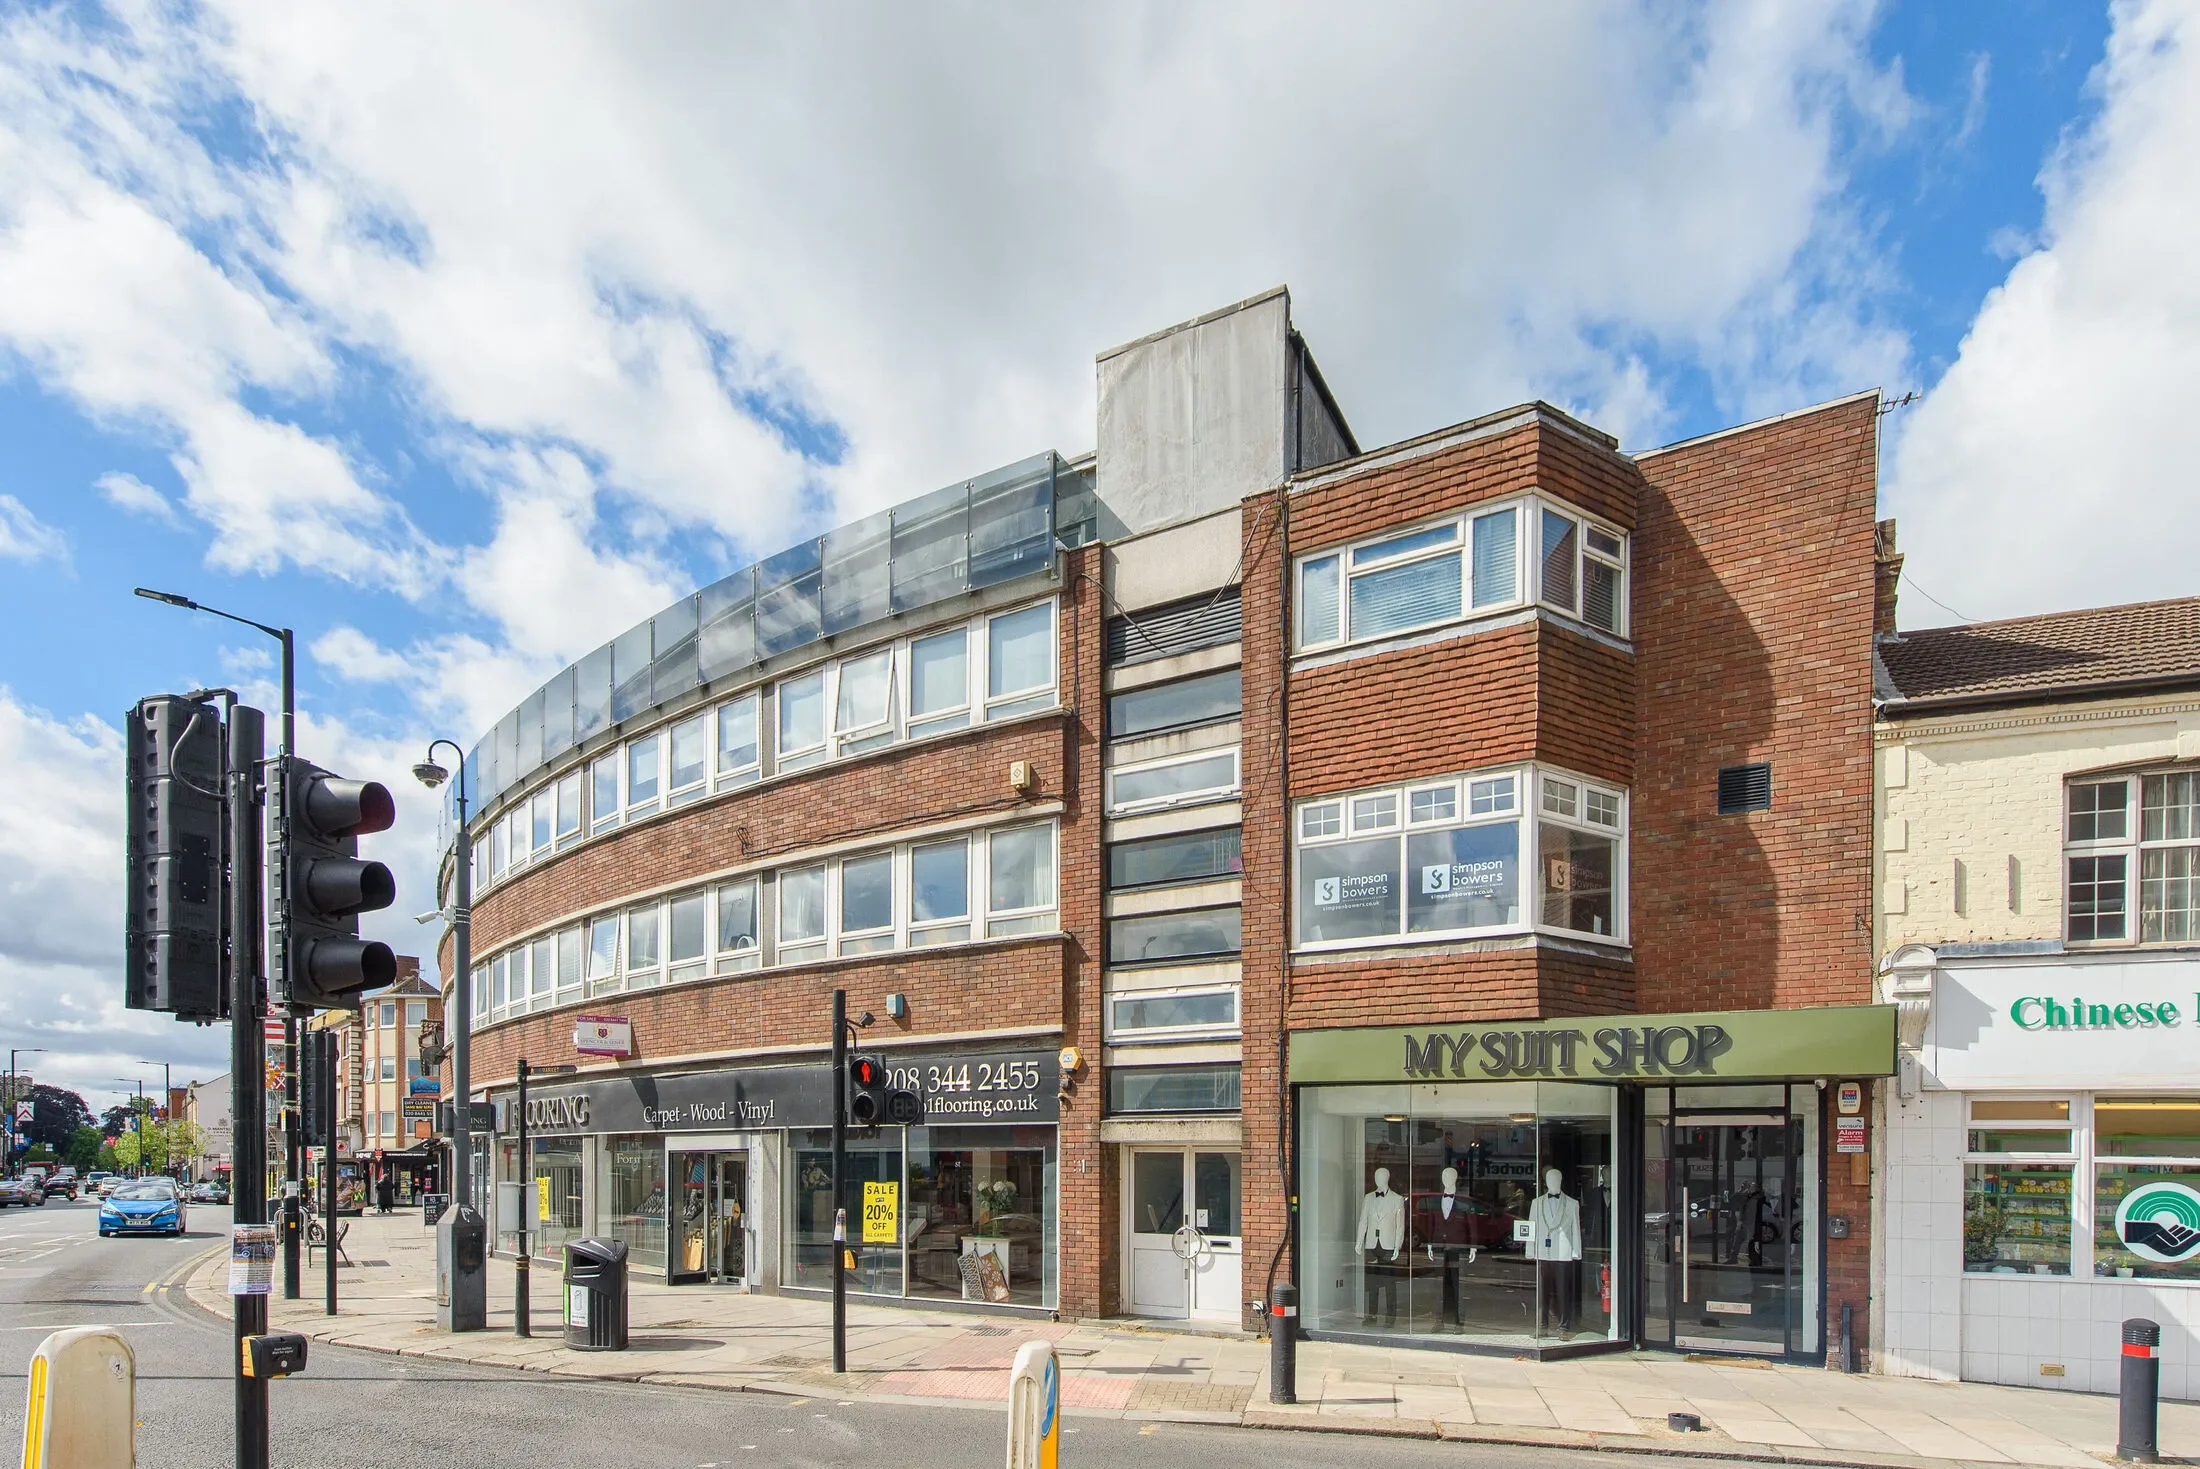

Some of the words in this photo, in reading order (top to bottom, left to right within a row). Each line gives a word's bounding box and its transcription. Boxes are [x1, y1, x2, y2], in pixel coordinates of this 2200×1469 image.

[1452, 860, 1503, 875] simpson
[1342, 873, 1388, 887] simpson
[1452, 872, 1503, 886] bowers
[1342, 884, 1388, 898] bowers
[2010, 995, 2177, 1027] Chinese
[1404, 1033, 1472, 1071] MY
[1479, 1028, 1586, 1070] SUIT
[1592, 1024, 1728, 1070] SHOP
[885, 1066, 920, 1091] 208
[927, 1063, 971, 1093] 344
[977, 1060, 1040, 1091] 2455
[511, 1095, 588, 1128] FOORING
[643, 1105, 680, 1128] Carpet
[690, 1101, 726, 1121] Wood
[737, 1099, 775, 1125] Vinyl
[866, 1185, 895, 1195] SALE
[866, 1204, 894, 1221] 20%
[872, 1222, 886, 1230] OFF
